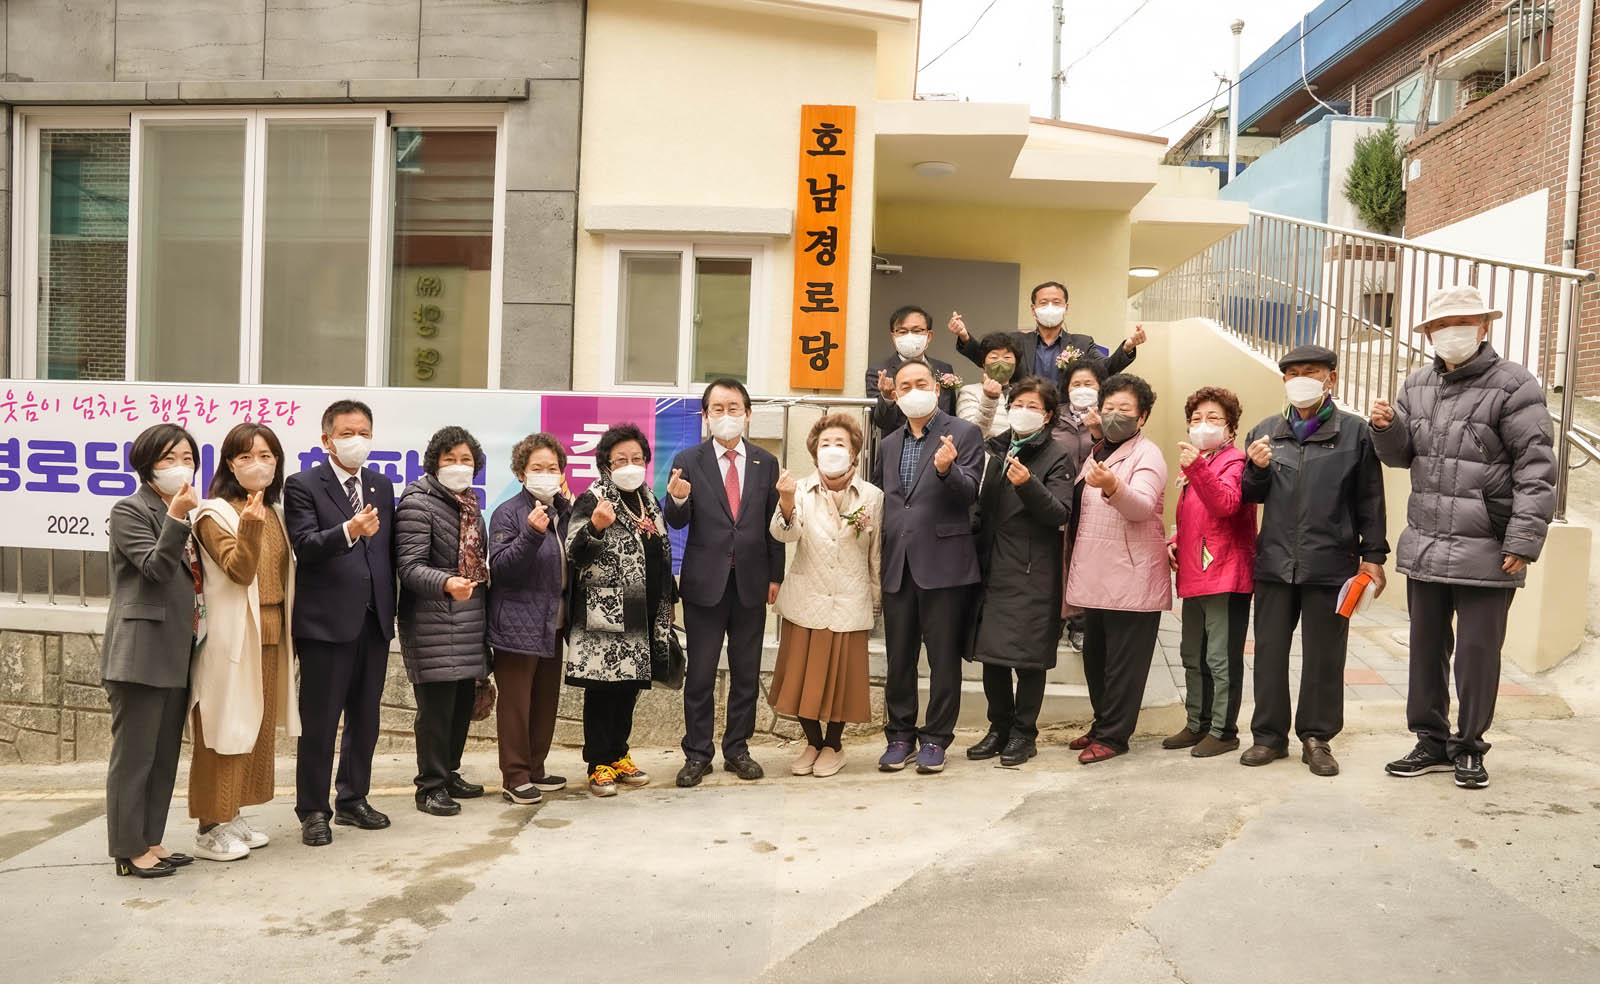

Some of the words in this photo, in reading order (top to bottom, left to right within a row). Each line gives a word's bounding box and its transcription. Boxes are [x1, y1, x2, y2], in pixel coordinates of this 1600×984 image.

[799, 122, 846, 372] 호남경로당
[0, 389, 60, 423] 웃음이
[73, 394, 139, 421] 넘치는
[150, 394, 220, 430] 행복한
[230, 398, 301, 426] 경로당
[47, 515, 95, 536] 2022.
